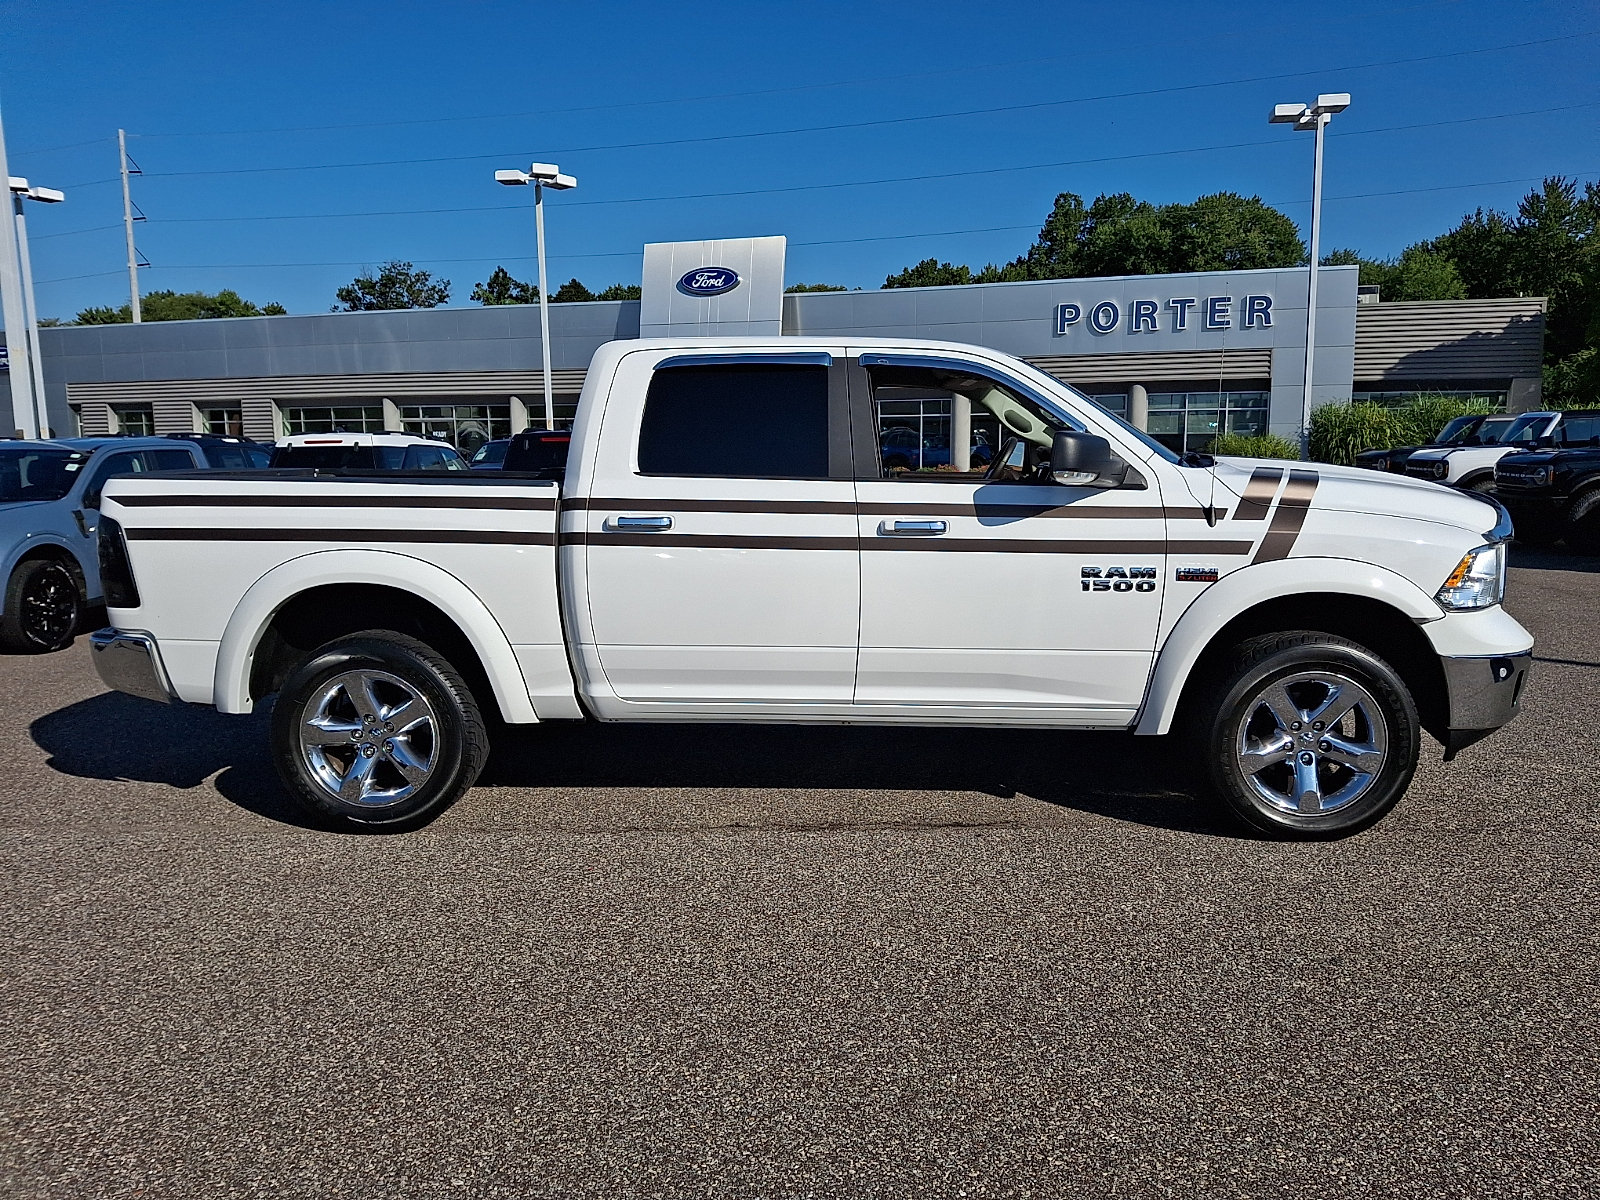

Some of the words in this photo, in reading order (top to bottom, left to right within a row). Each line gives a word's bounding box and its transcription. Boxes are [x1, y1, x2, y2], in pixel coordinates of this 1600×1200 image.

[692, 272, 725, 288] Ford
[1057, 294, 1274, 335] PORTER
[1081, 566, 1157, 579] RAM
[1177, 567, 1219, 575] HEMI
[1080, 579, 1156, 592] 1500
